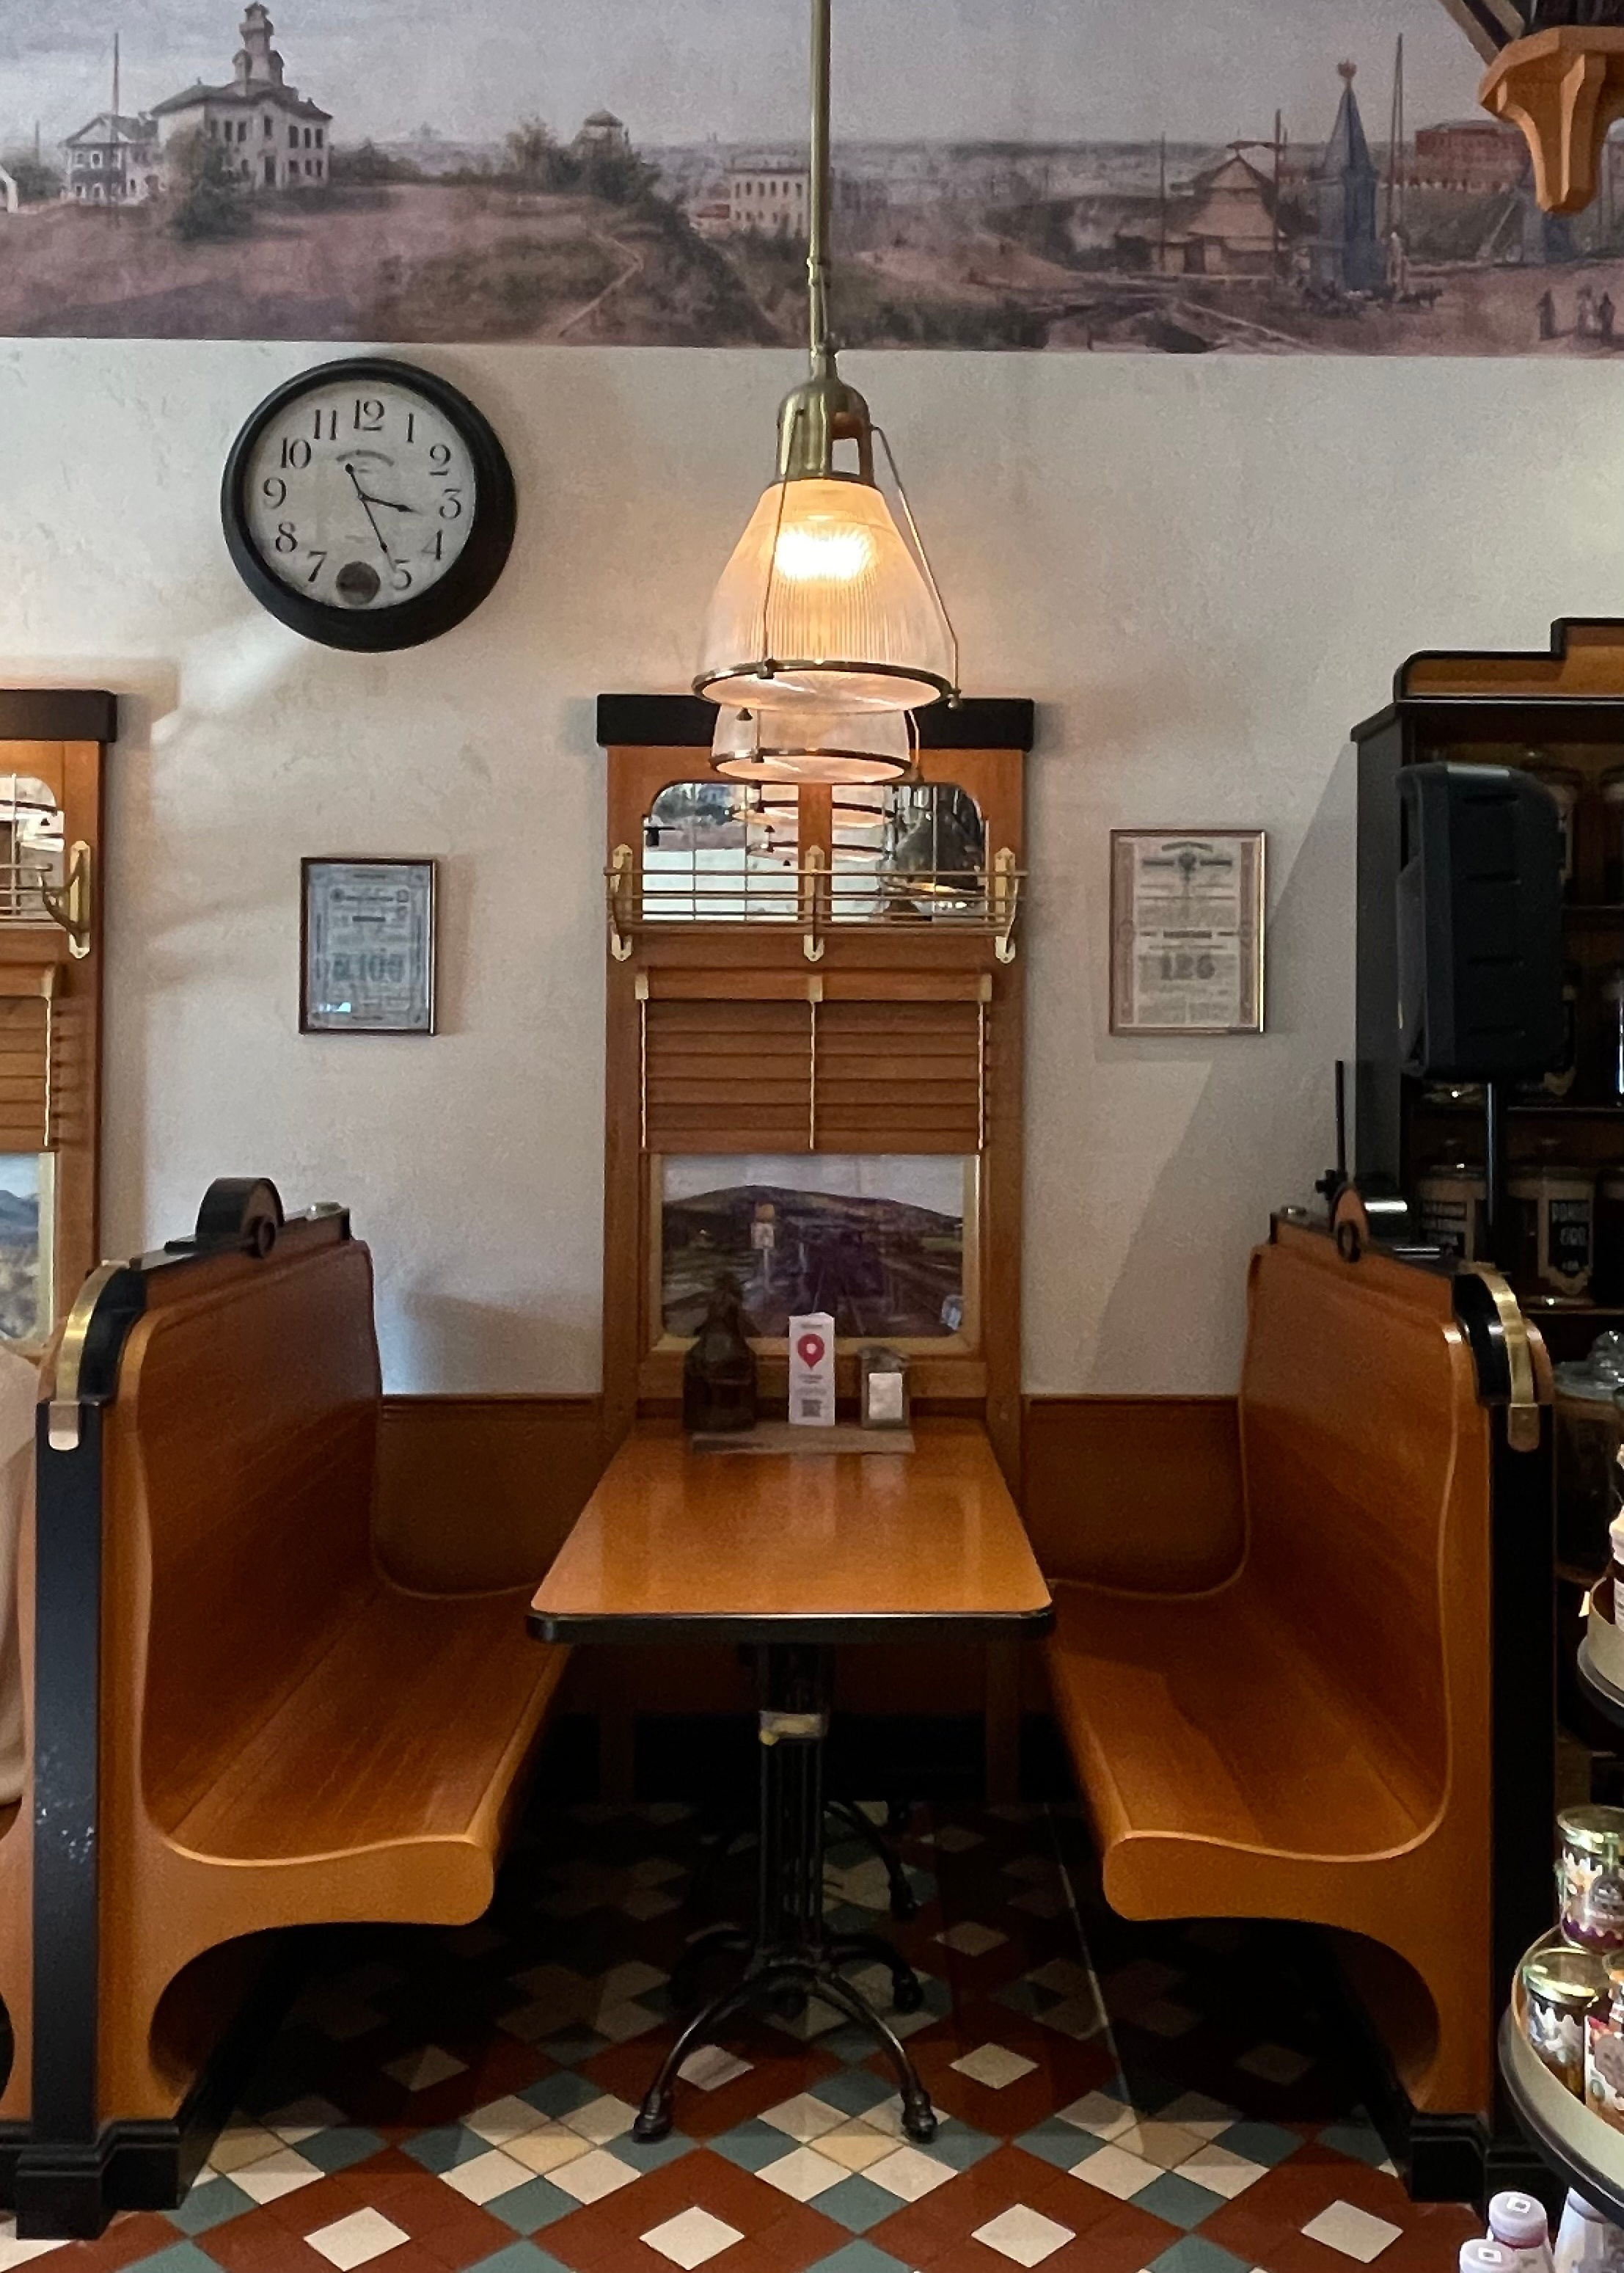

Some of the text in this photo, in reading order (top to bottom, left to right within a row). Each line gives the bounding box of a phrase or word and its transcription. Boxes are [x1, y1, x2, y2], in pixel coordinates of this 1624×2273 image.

[313, 409, 337, 440] 11
[354, 399, 385, 431] 12
[406, 412, 414, 443] 1
[279, 438, 312, 468] 10
[429, 443, 452, 475] 2
[263, 477, 287, 509] 9
[439, 488, 461, 519] 3
[274, 521, 299, 553] 8
[420, 529, 444, 561] 4
[306, 551, 328, 583] 7
[392, 558, 413, 591] 5
